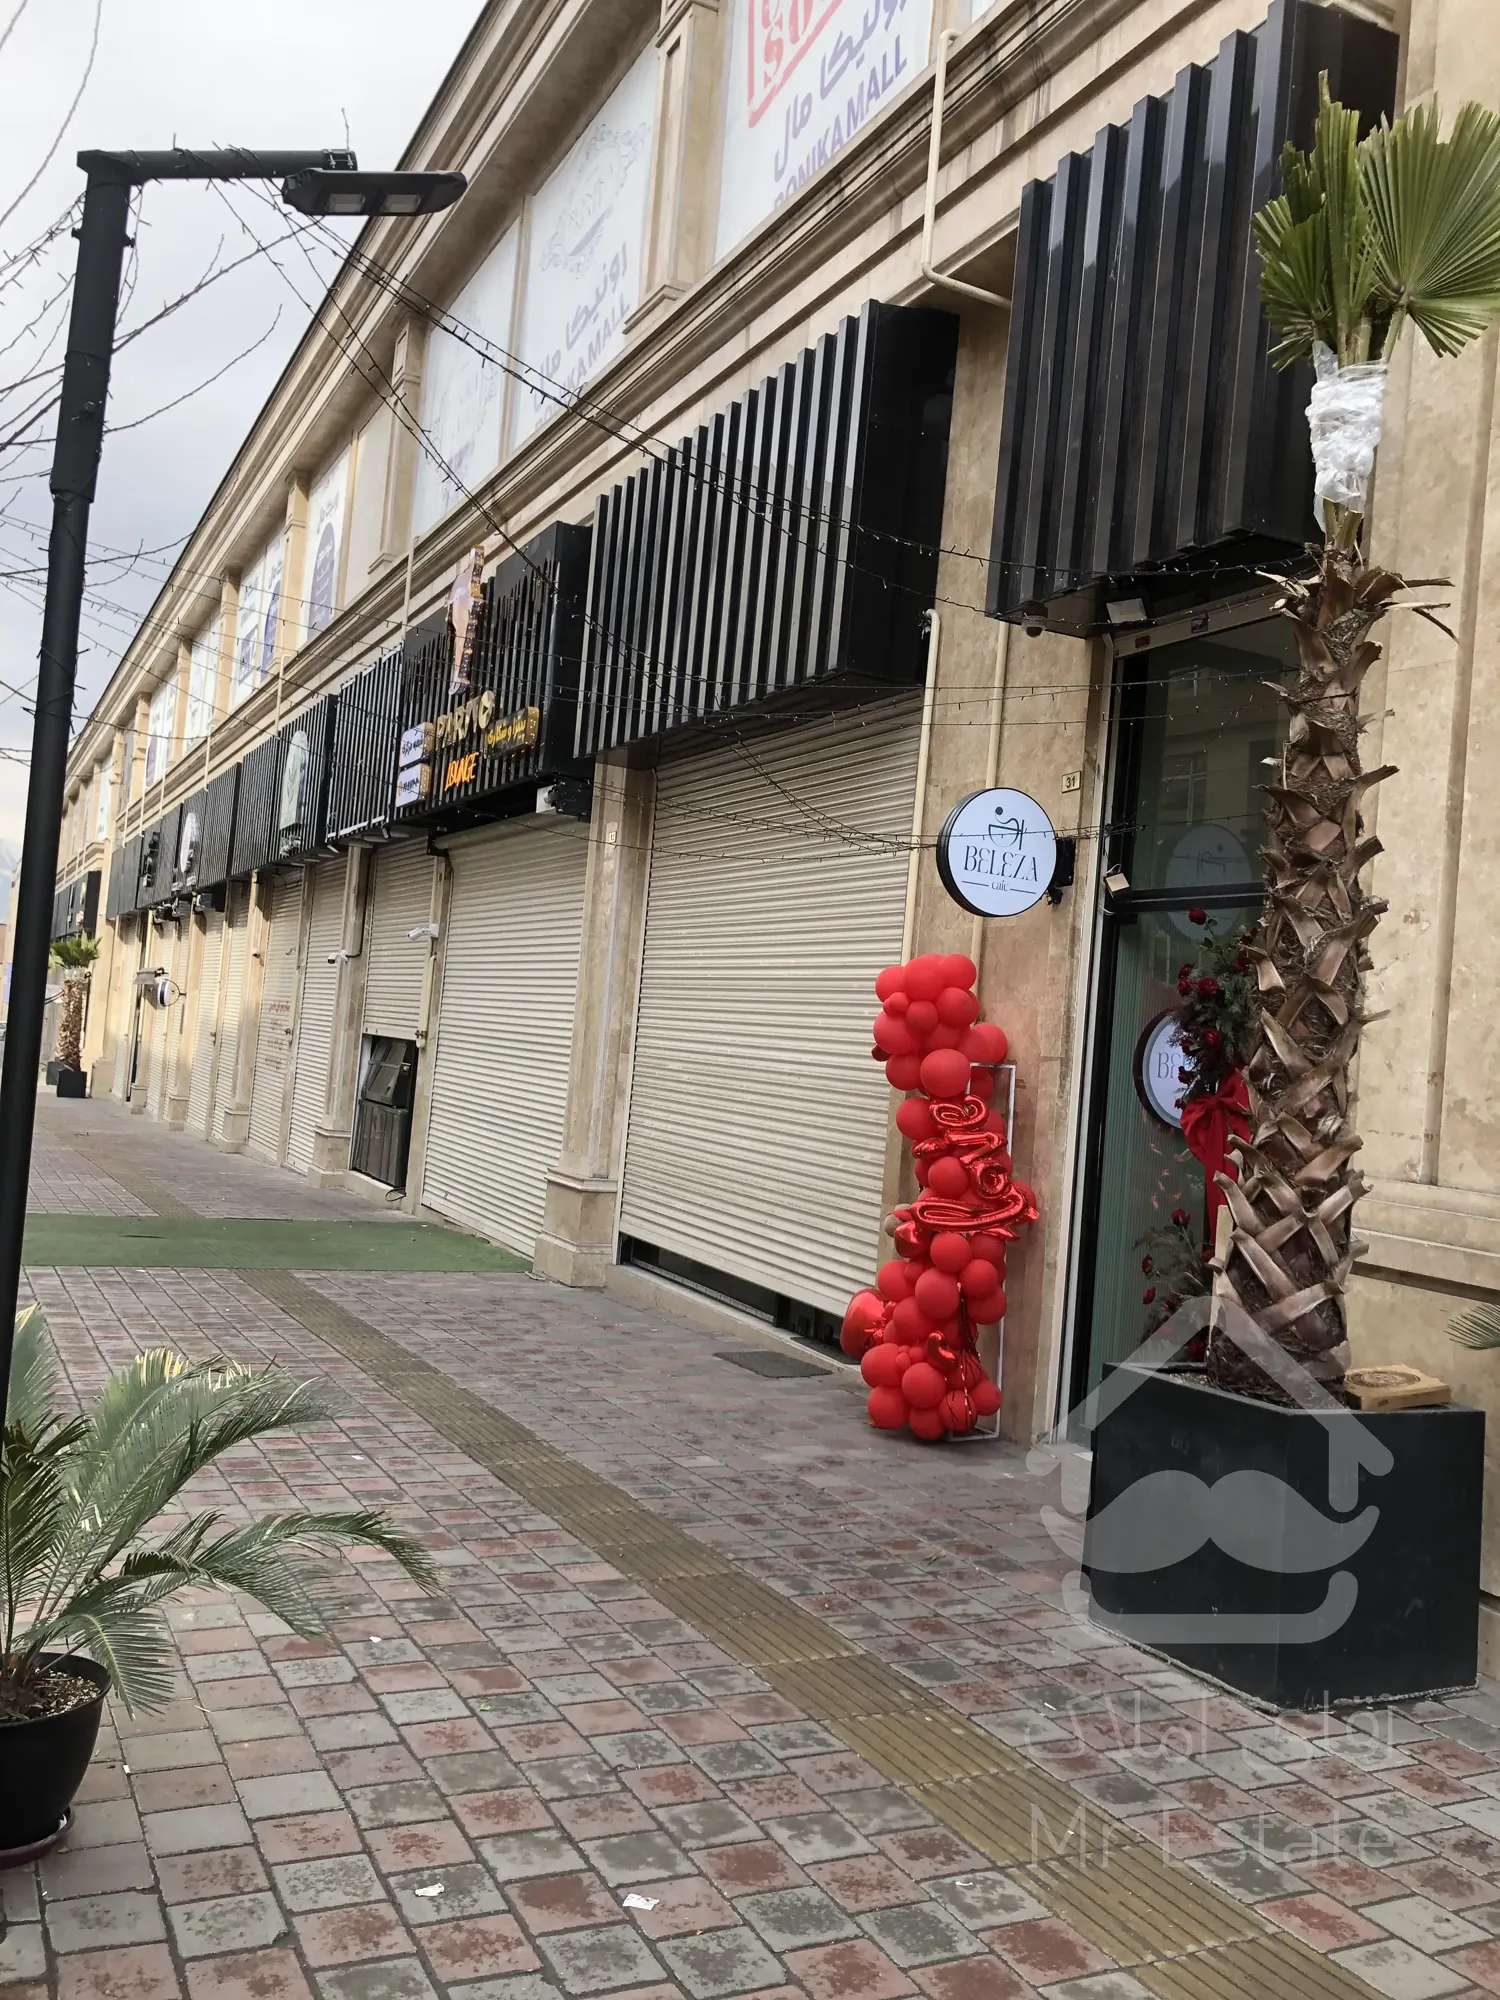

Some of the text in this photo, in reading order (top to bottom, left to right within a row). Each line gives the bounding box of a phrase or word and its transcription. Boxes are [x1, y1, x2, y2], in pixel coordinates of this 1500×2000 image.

[444, 751, 480, 792] LOUNGE
[1065, 775, 1077, 789] 31
[963, 844, 1039, 883] BELEZA
